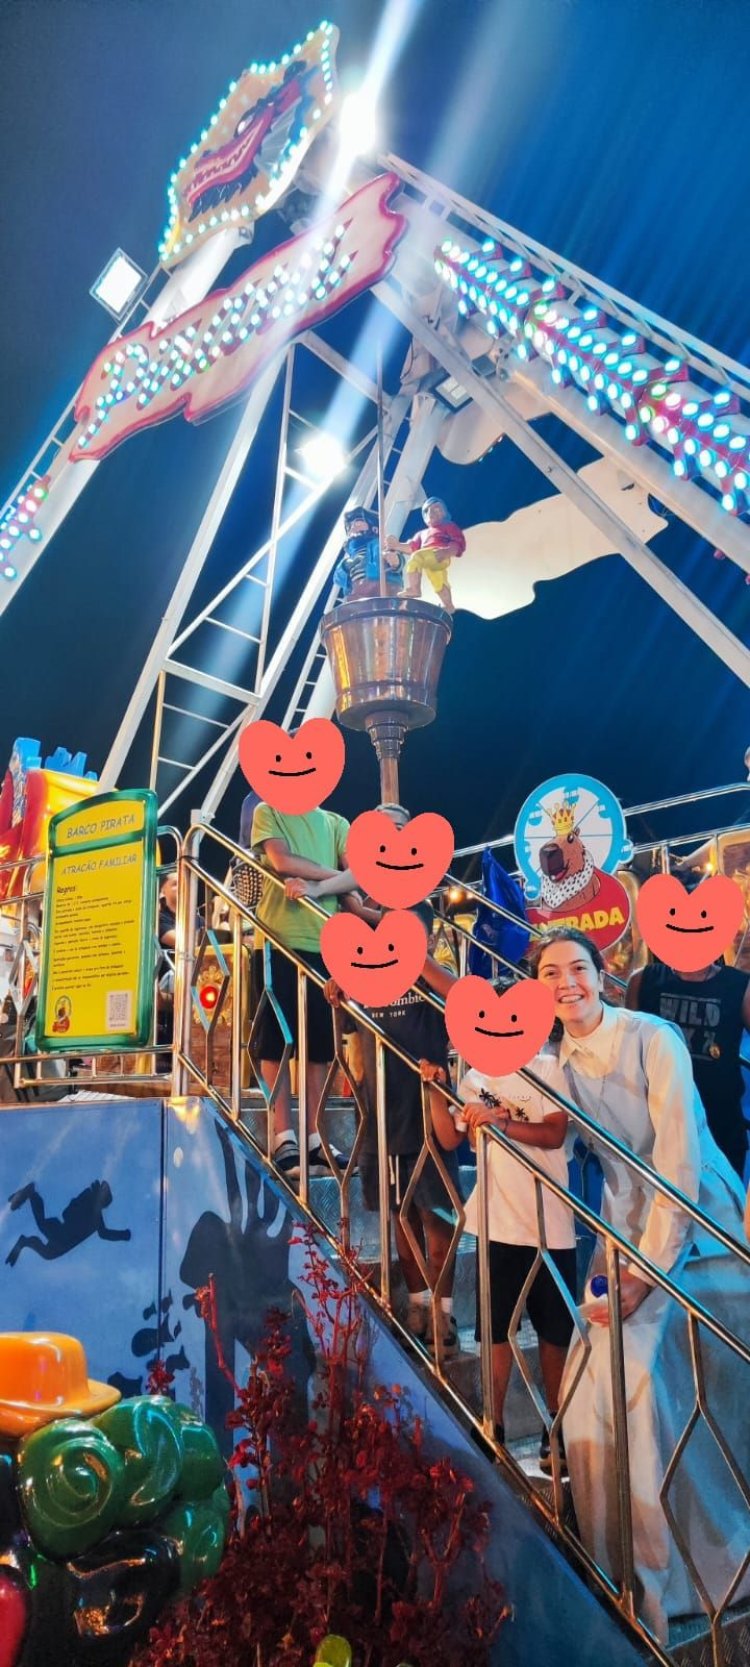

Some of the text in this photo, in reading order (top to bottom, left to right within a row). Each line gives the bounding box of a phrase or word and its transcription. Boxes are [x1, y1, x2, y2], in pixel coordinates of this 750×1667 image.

[67, 815, 135, 838] BARCO PIRATA
[98, 854, 137, 869] FAMILIAR
[389, 1010, 406, 1018] YORK
